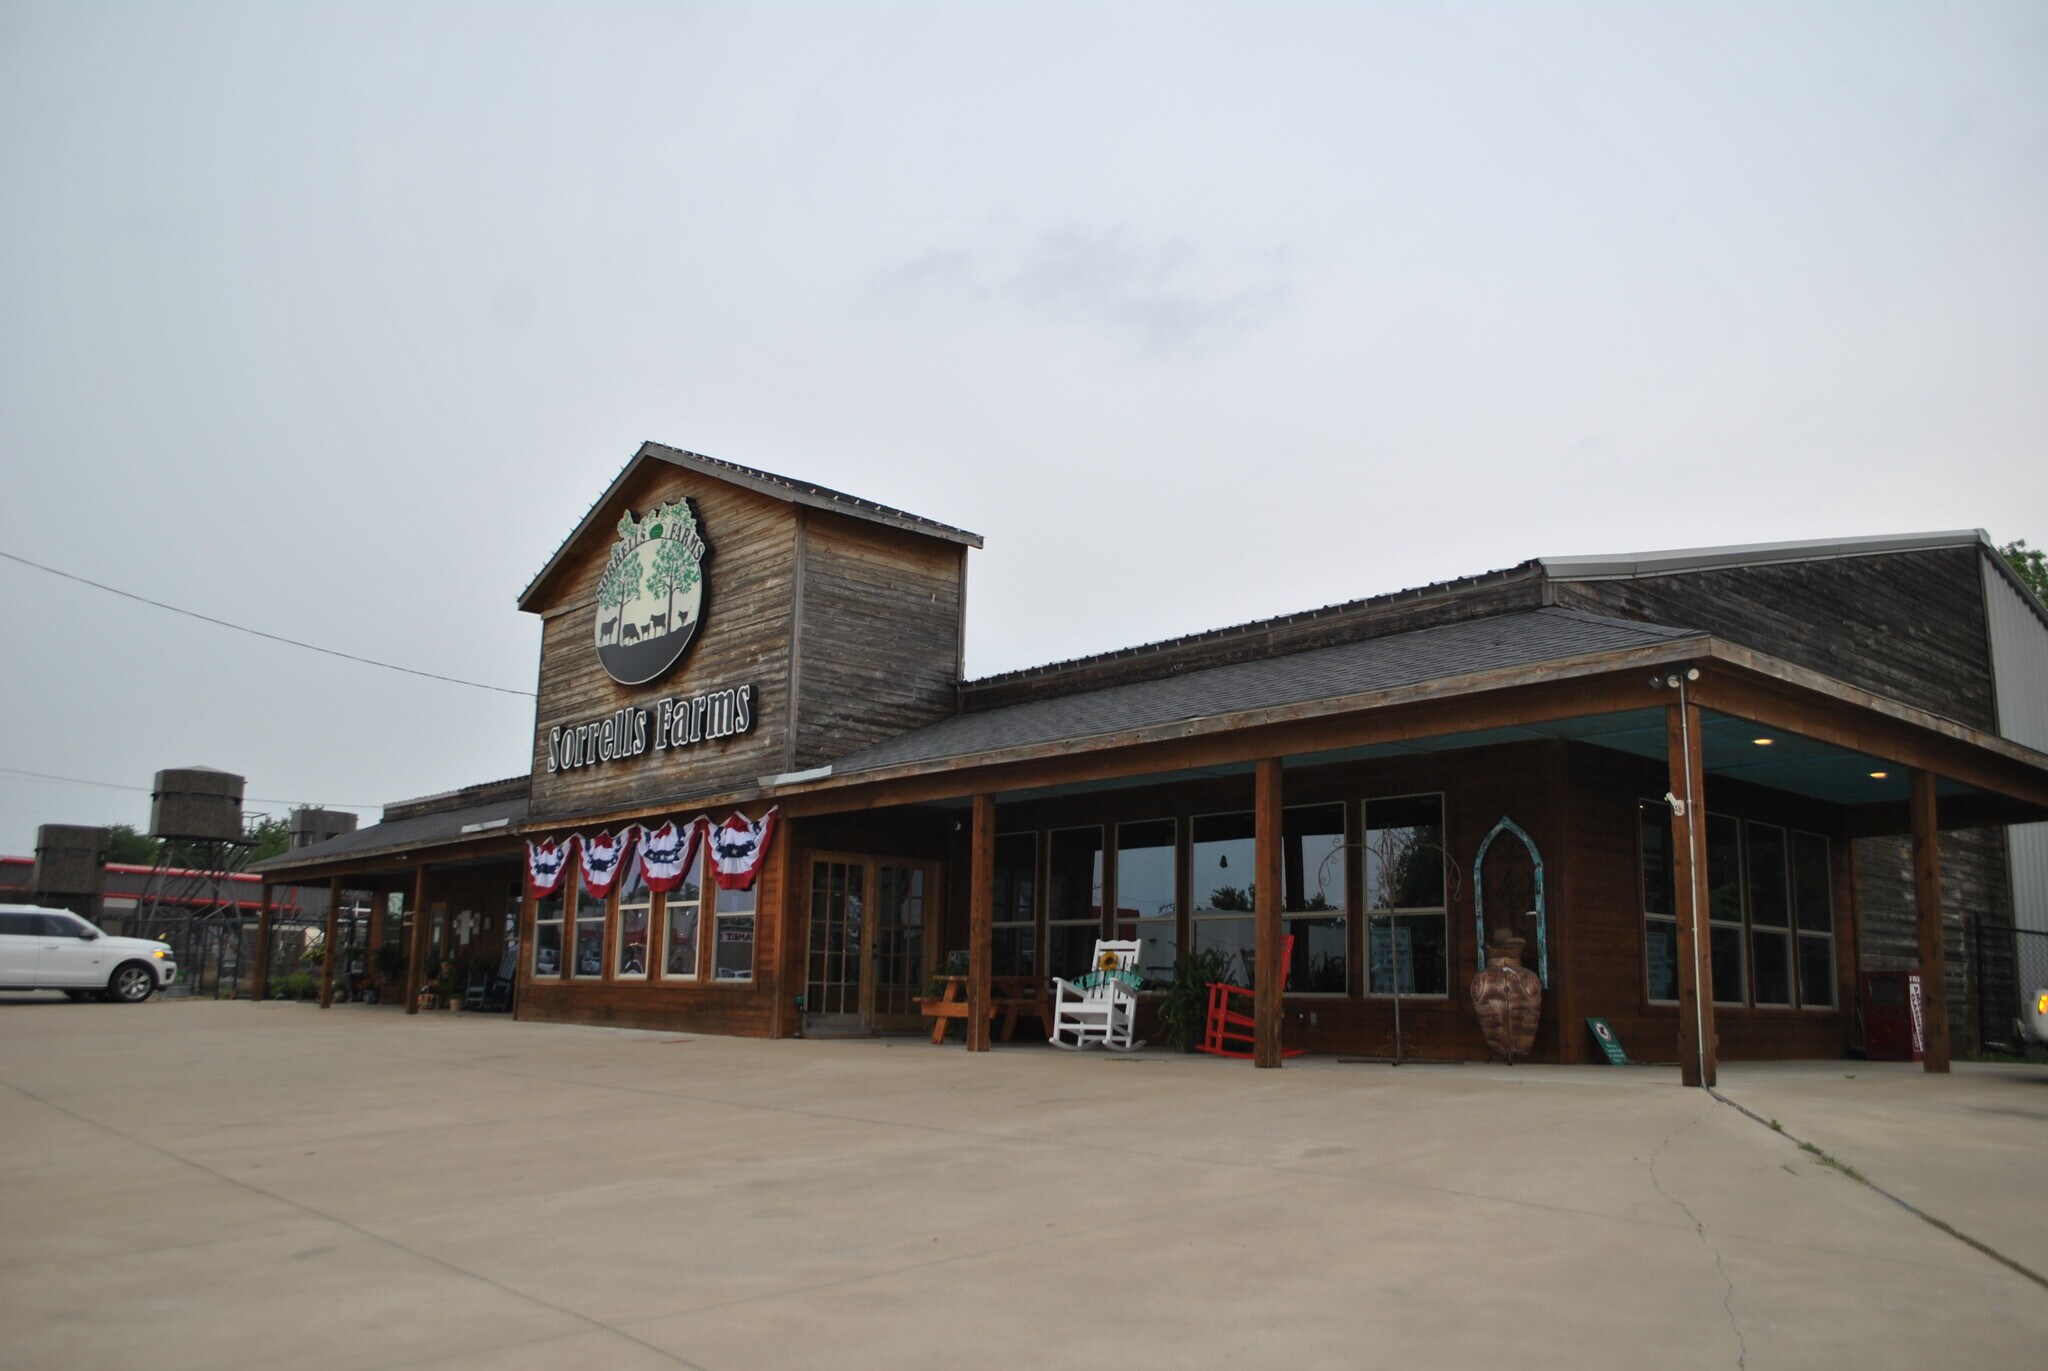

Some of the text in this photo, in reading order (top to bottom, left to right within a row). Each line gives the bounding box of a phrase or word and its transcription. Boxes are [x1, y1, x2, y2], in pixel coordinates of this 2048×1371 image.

[597, 523, 704, 597] SORRELLS FARMS
[548, 685, 750, 773] Sorrells Farms
